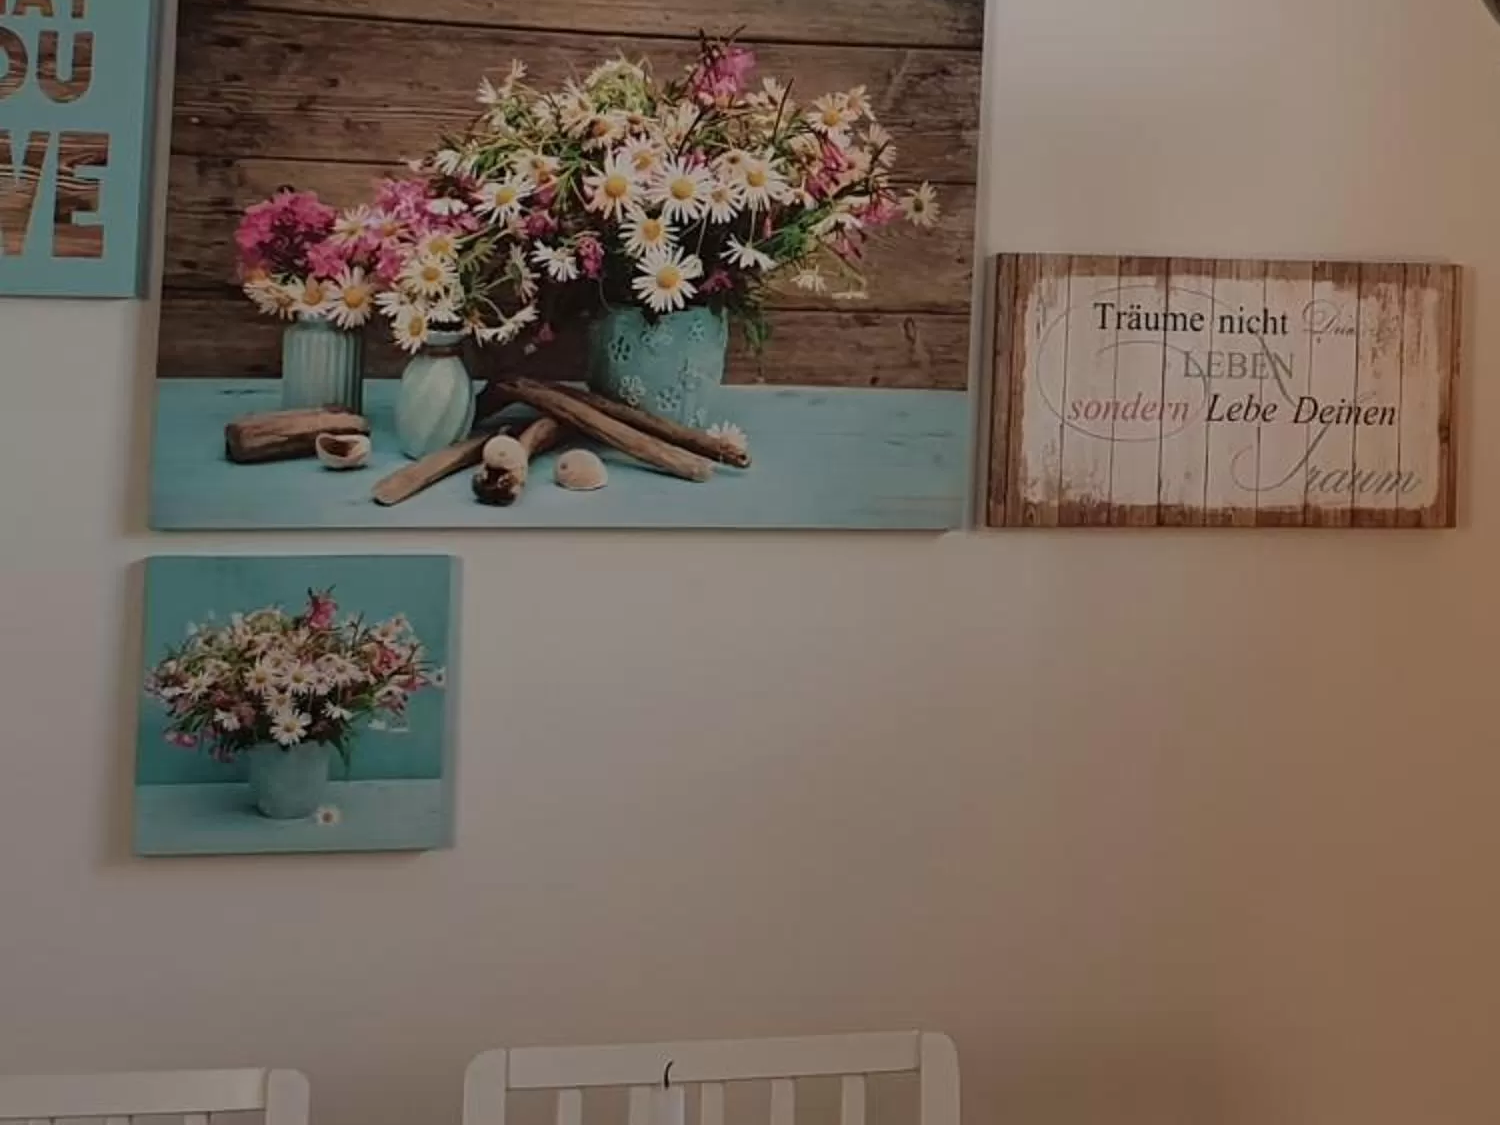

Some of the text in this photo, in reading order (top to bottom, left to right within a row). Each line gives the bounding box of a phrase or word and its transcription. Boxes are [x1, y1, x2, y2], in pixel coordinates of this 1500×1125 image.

[1094, 302, 1205, 332] Träume
[1218, 306, 1289, 335] nicht
[1183, 350, 1294, 380] LEBEN
[1067, 391, 1396, 426] sondern Lebe Deinen
